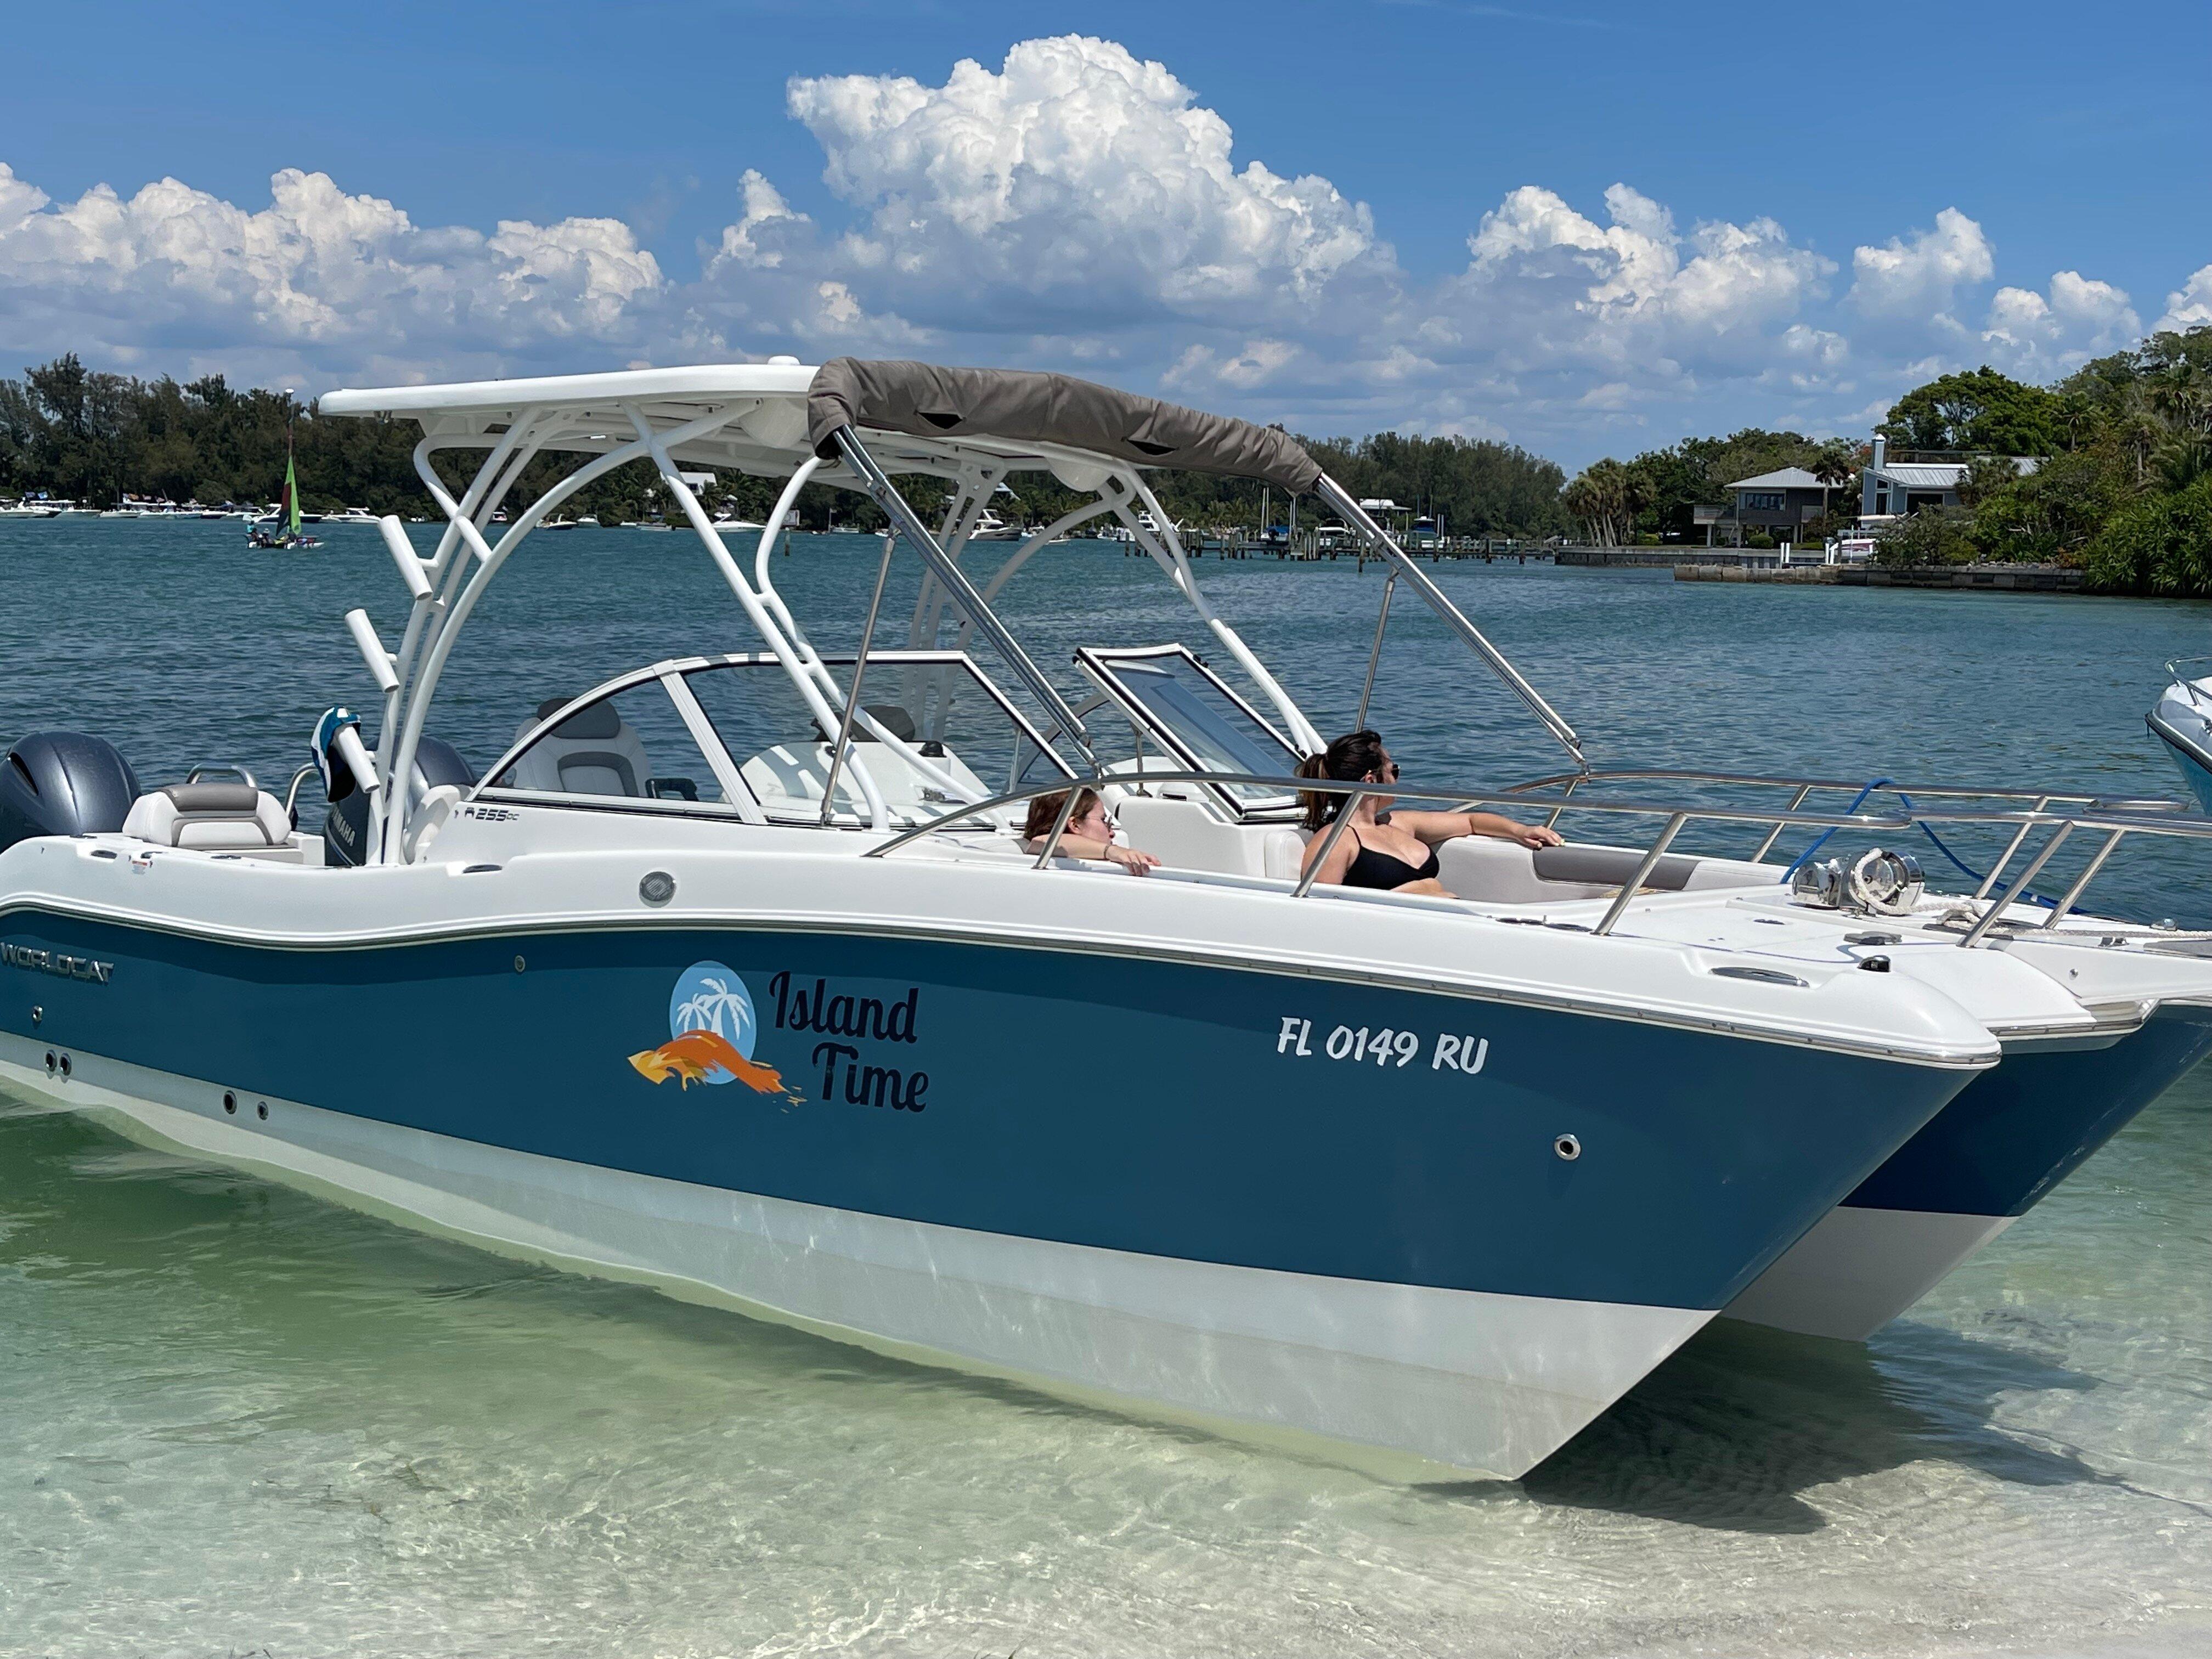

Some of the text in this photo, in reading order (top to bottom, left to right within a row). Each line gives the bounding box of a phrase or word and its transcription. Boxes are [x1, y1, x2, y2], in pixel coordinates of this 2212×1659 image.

[770, 970, 919, 1043] Island
[812, 1042, 929, 1113] Time
[1277, 1017, 1489, 1074] FL 0149 RU
